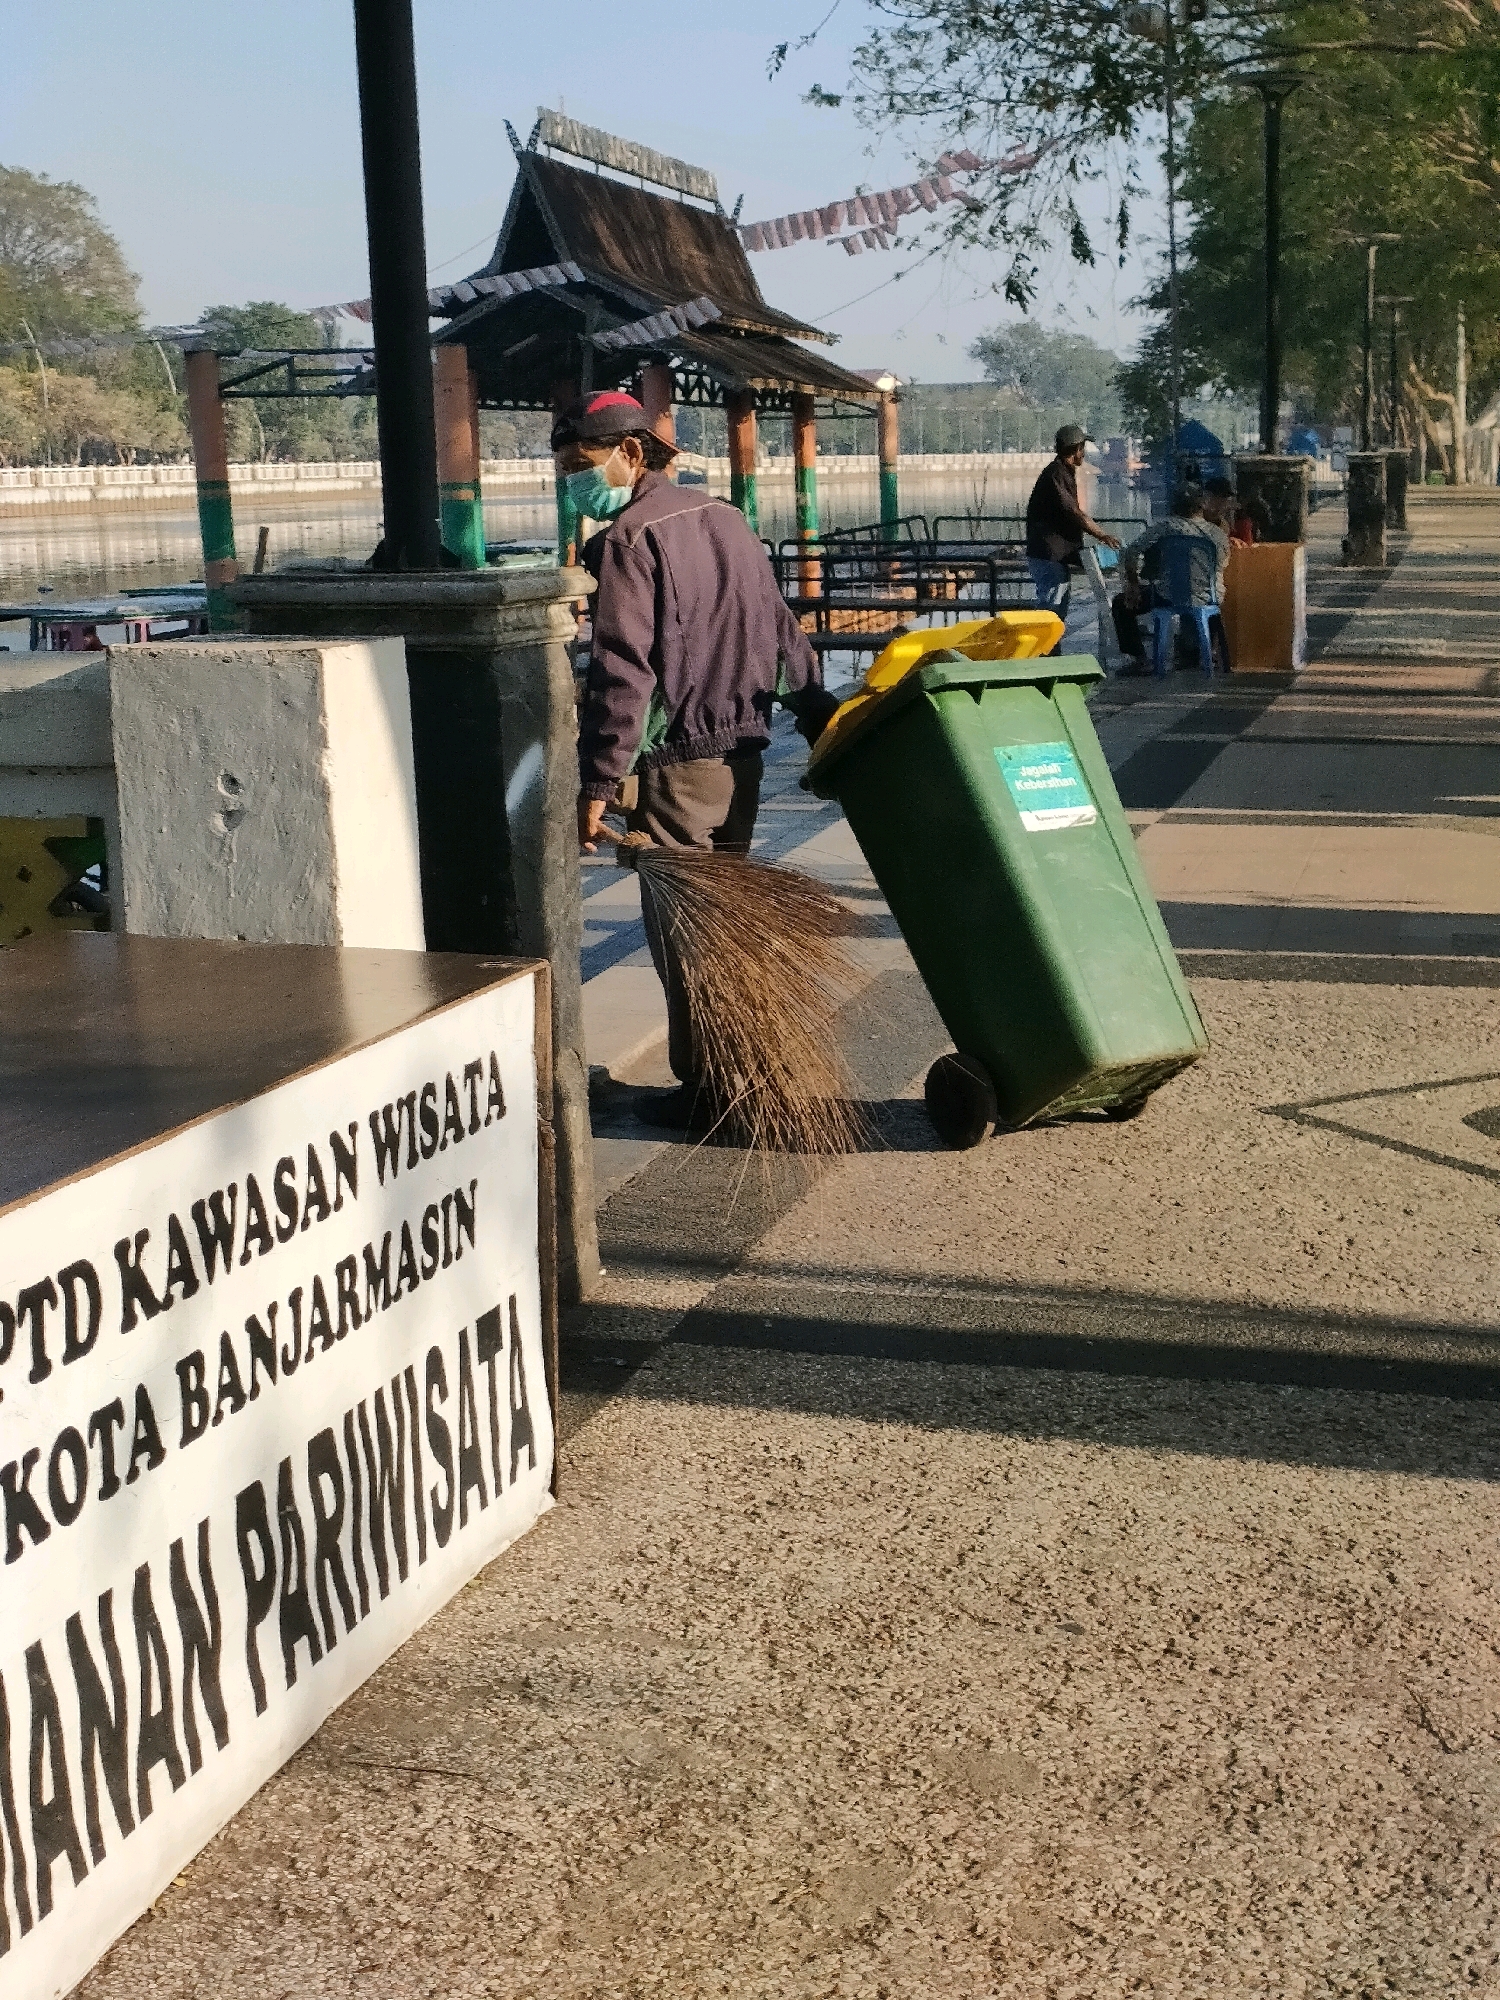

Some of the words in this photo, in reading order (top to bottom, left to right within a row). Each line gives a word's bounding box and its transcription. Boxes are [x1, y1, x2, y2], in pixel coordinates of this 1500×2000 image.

[1014, 777, 1078, 791] Kebersihan
[113, 1121, 359, 1335] KAWASAN
[368, 1050, 507, 1187] WISATA
[0, 1382, 167, 1566] KOTA
[175, 1178, 478, 1450] BANJARMASIN
[235, 1294, 536, 1718] PARIWISATA
